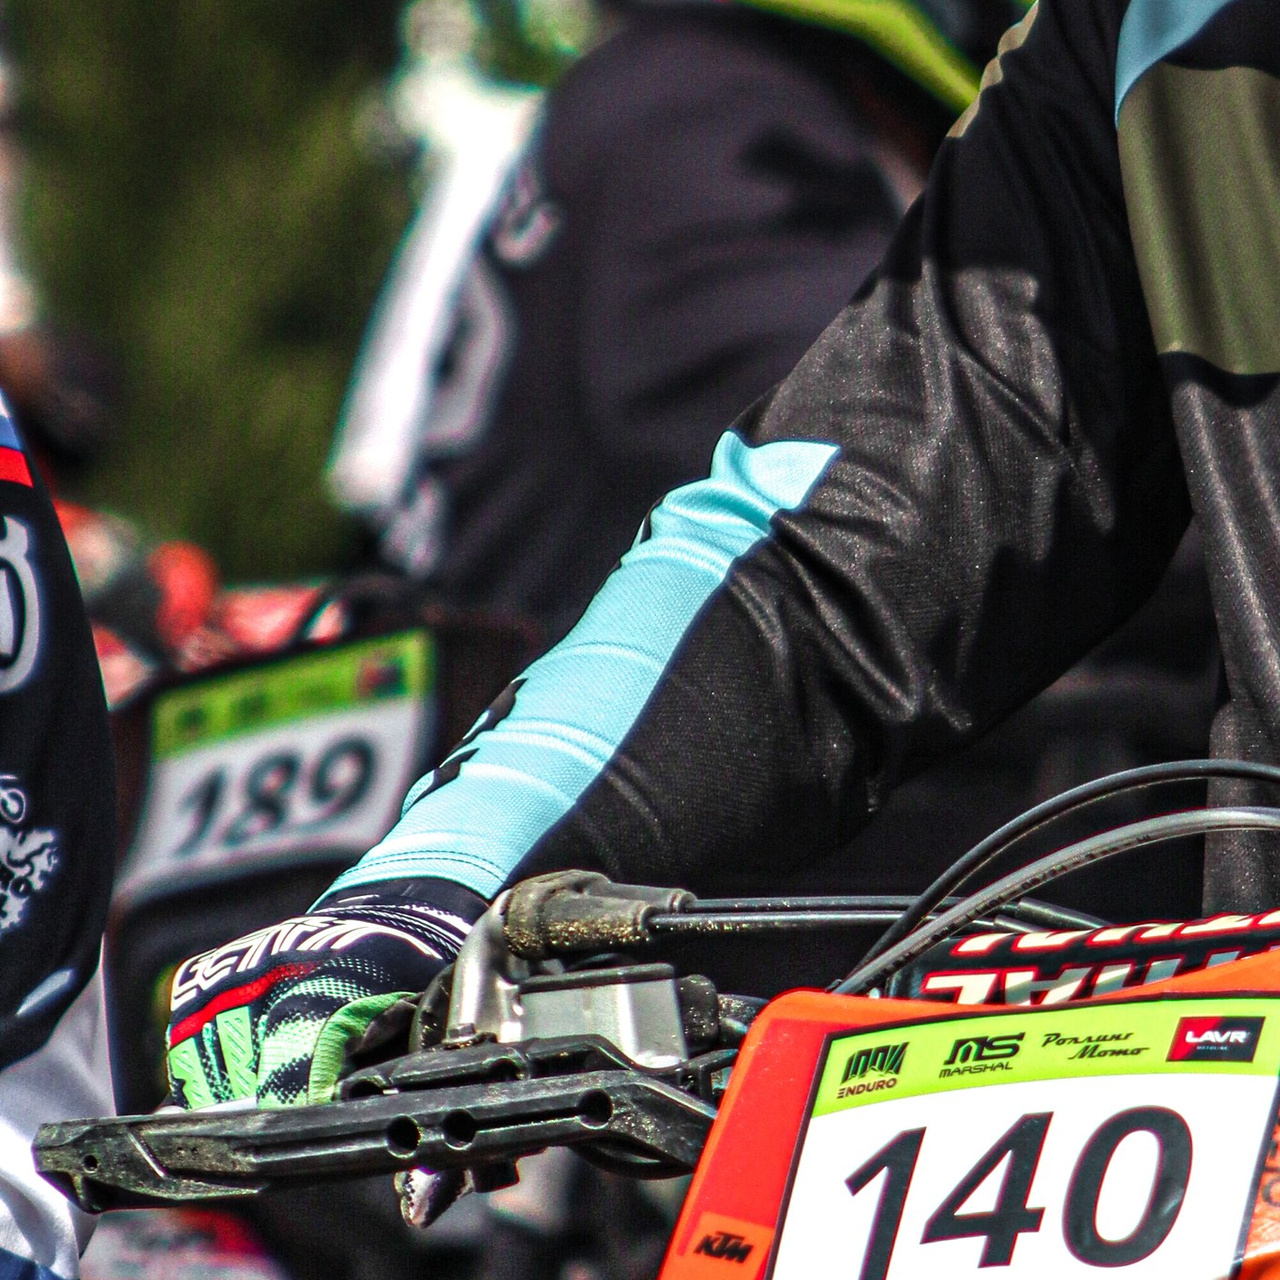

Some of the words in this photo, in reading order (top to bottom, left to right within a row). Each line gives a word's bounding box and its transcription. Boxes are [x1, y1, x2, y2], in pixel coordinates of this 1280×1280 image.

[172, 733, 377, 858] 189
[1185, 1030, 1248, 1044] LAVR
[939, 1061, 1013, 1079] MARSHAL
[837, 1077, 898, 1100] ENDURO
[693, 1230, 755, 1264] KTM
